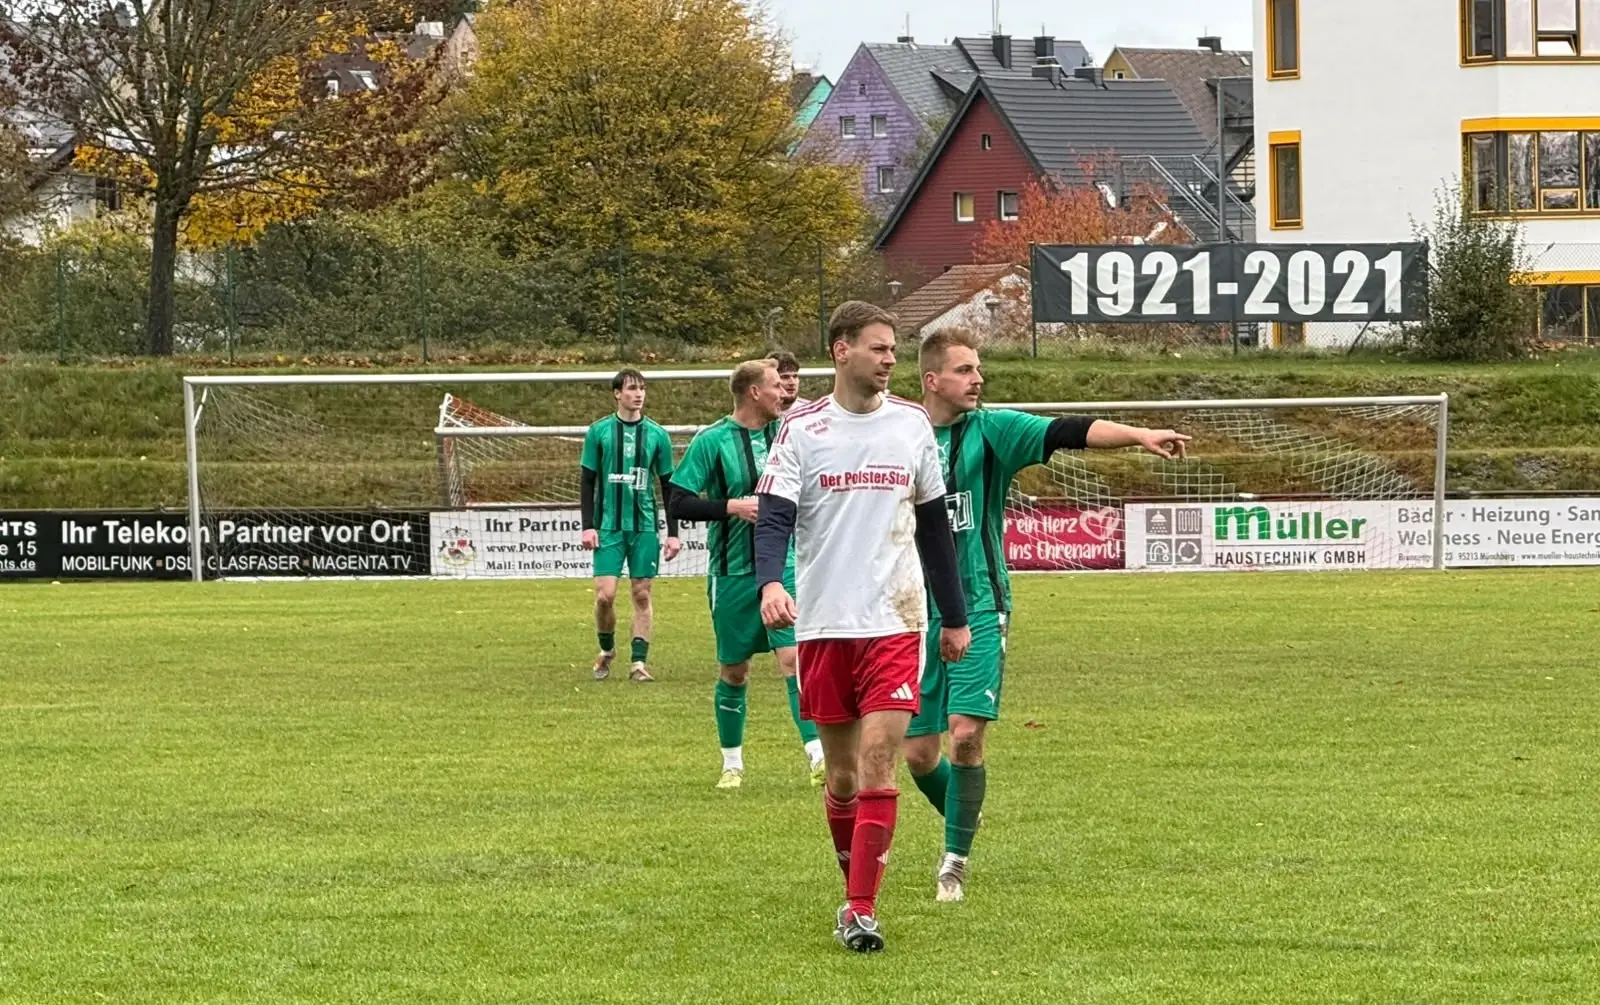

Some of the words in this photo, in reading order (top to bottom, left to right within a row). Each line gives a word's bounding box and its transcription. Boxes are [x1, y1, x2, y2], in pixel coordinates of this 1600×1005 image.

[1060, 249, 1403, 316] 1921-2021
[820, 473, 842, 488] Der
[1215, 505, 1367, 540] müller
[1398, 507, 1454, 523] Bädr
[1472, 506, 1550, 526] Heizung
[1567, 505, 1600, 521] San
[62, 520, 97, 544] Ihr
[218, 520, 314, 543] Partner
[320, 525, 364, 543] vor
[370, 519, 412, 543] Ort
[485, 518, 513, 532] Ihr
[1016, 517, 1039, 533] ein
[1043, 516, 1078, 533] Herz
[1397, 529, 1481, 546] Welness
[1497, 529, 1546, 545] Neue
[16, 541, 37, 556] 15
[1009, 541, 1032, 560] ins
[1037, 539, 1121, 560] Ehrenamt!
[1323, 550, 1366, 564] GMBH
[62, 556, 154, 571] MOBILFUNK
[165, 556, 192, 571] DSL
[207, 555, 301, 571] GLASFASER
[312, 555, 389, 570] MAGENTA
[391, 555, 412, 569] TV
[486, 560, 516, 570] Mail:
